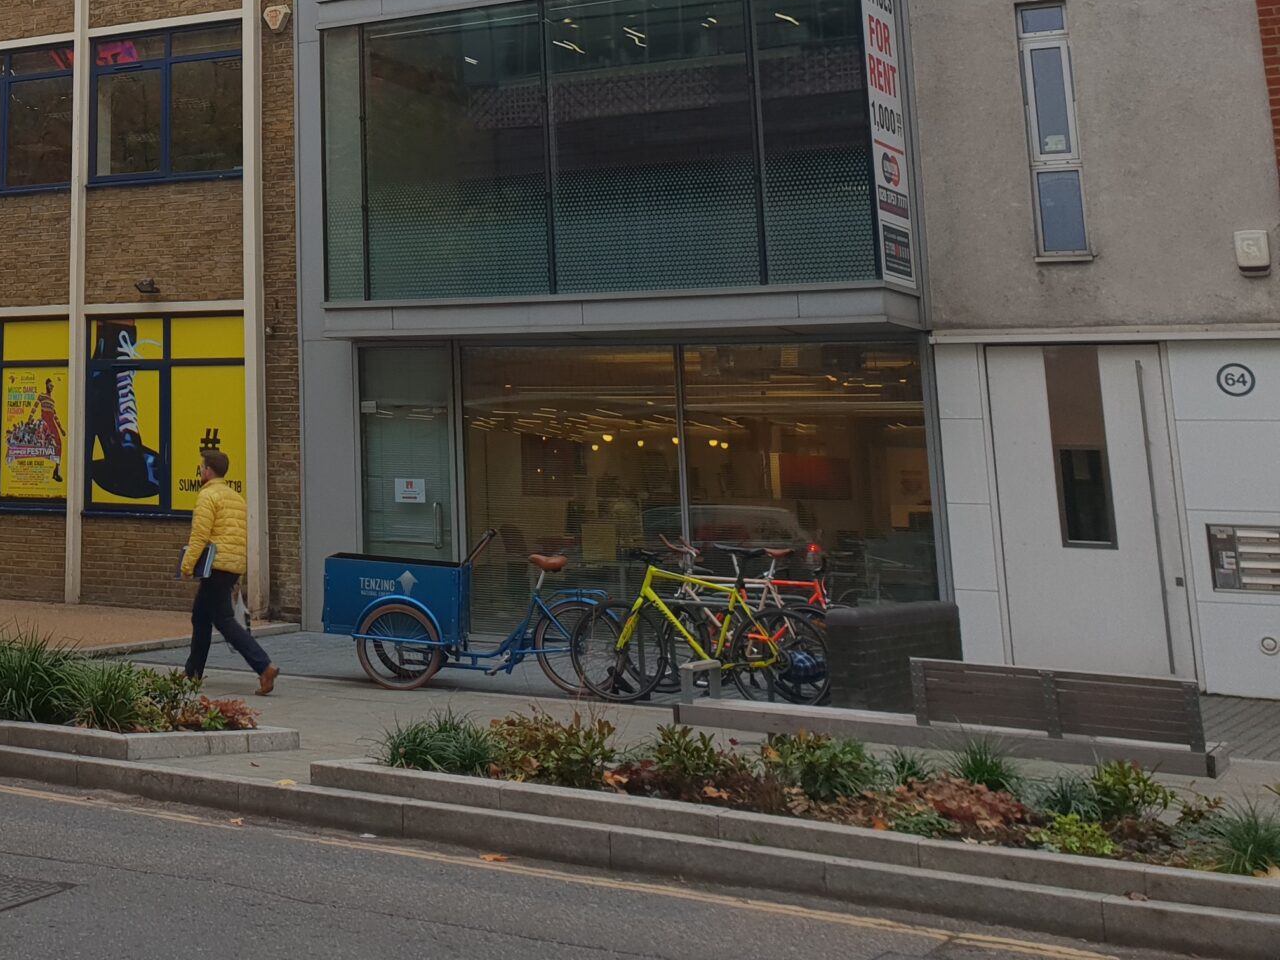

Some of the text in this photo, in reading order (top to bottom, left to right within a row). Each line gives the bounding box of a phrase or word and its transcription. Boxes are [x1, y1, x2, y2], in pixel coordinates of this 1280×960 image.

[868, 13, 892, 58] FOR
[868, 52, 897, 98] RENT
[871, 100, 896, 135] 1,000
[1224, 372, 1248, 387] 64
[27, 446, 56, 455] FESTIVAL
[360, 577, 395, 591] TENZING
